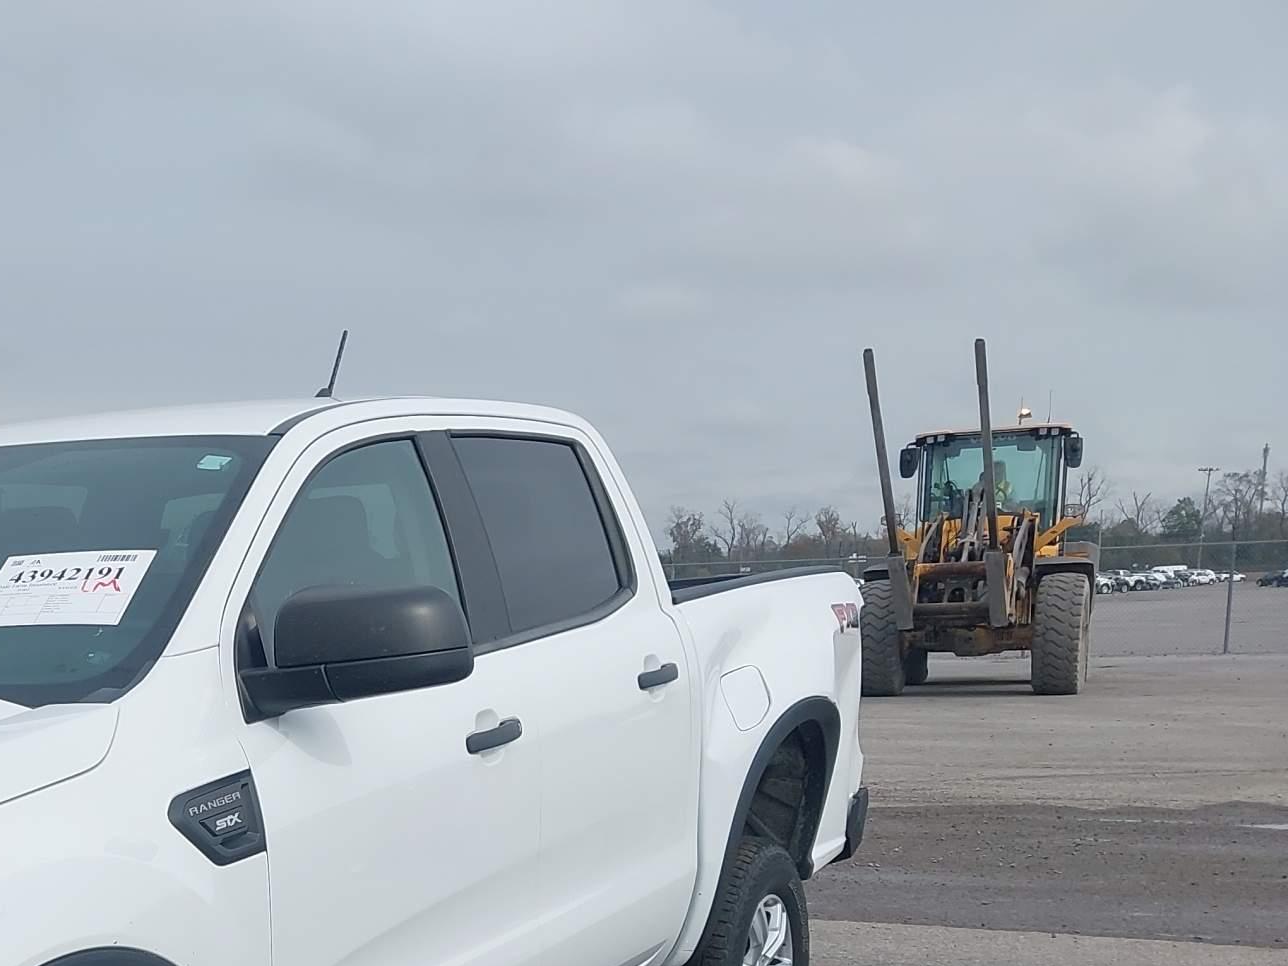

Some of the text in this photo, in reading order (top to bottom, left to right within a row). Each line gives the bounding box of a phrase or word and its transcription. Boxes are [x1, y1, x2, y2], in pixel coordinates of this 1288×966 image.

[9, 566, 125, 583] 43942191
[188, 791, 241, 817] RANGER
[215, 811, 243, 831] STX
